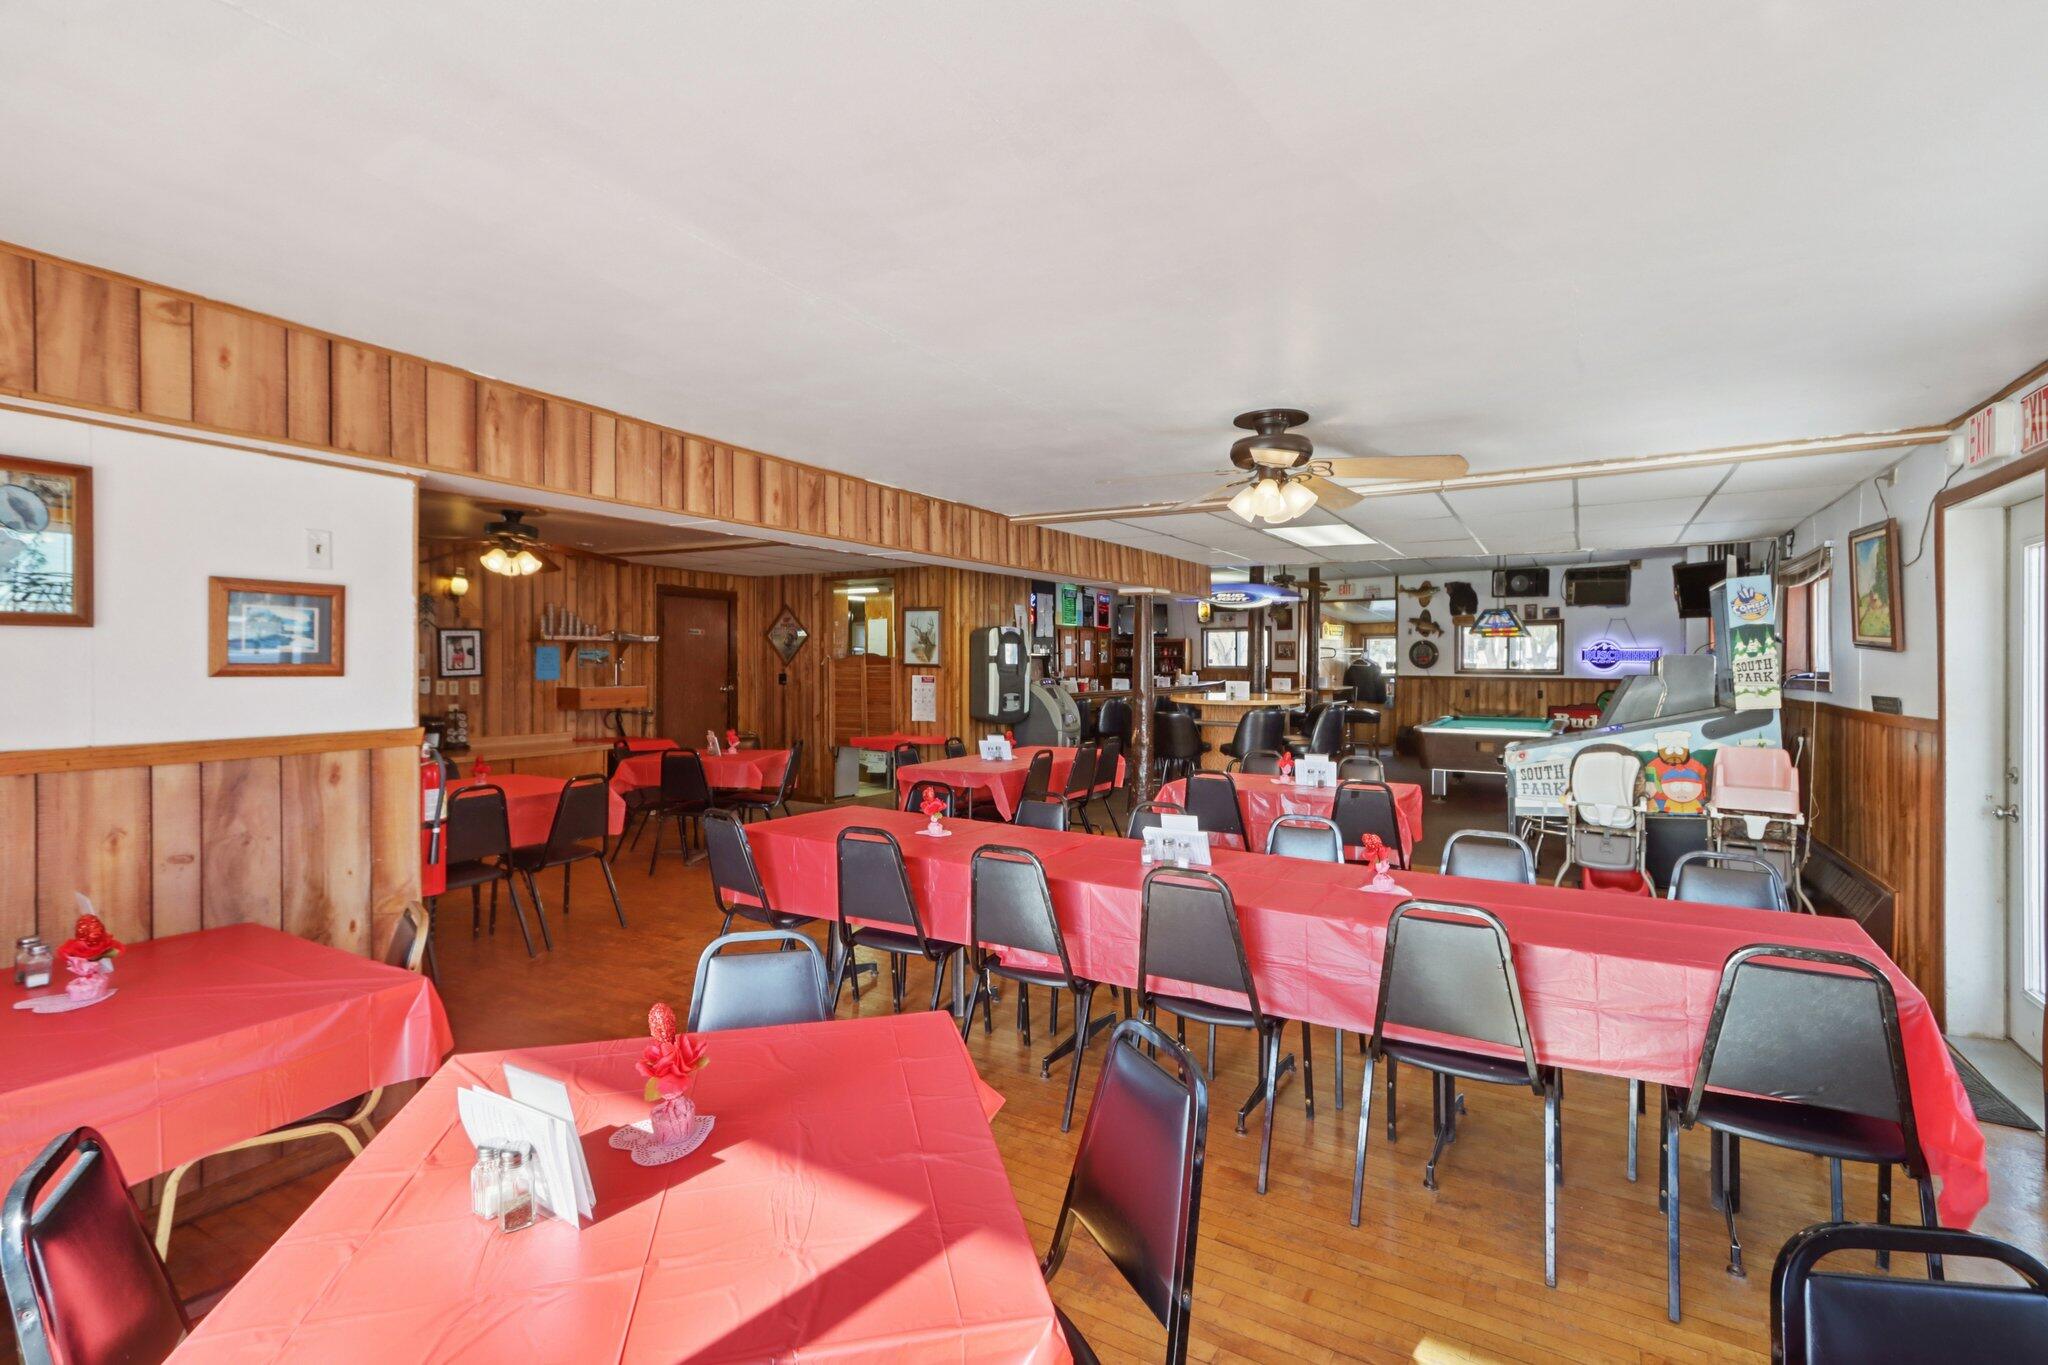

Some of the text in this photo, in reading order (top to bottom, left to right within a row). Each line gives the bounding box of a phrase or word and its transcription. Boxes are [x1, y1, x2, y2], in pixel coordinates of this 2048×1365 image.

[1969, 407, 1992, 464] EXIT
[1736, 658, 1773, 672] SOUTH
[1737, 671, 1775, 682] PARK
[1554, 713, 1599, 729] Bud
[1520, 764, 1567, 781] SOUTH
[1521, 782, 1566, 796] PARK
